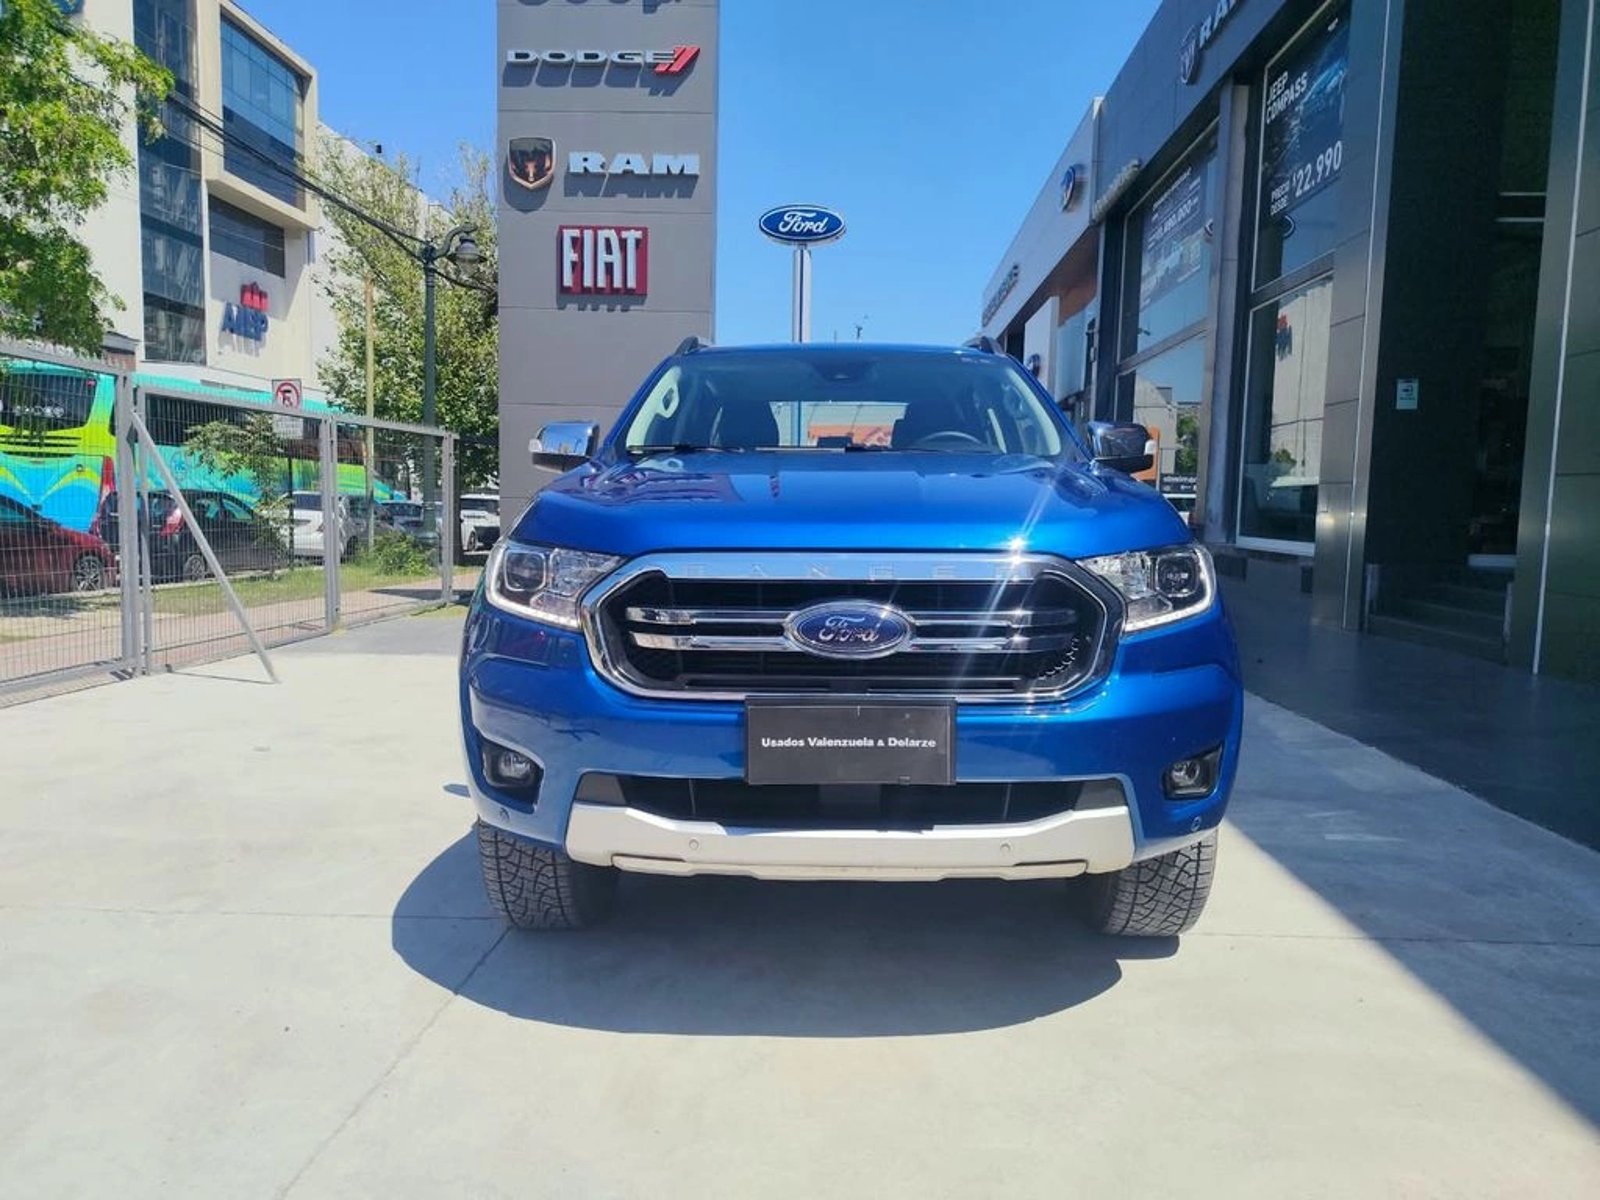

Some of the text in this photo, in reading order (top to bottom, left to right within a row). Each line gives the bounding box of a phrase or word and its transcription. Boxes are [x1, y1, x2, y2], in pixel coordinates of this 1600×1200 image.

[507, 49, 676, 64] DODGE
[1266, 72, 1307, 124] COMPASS
[1267, 71, 1288, 105] JEEP
[568, 151, 700, 175] RAM
[779, 211, 829, 232] Ford
[562, 228, 643, 289] FIAT
[819, 616, 879, 642] Ford
[762, 737, 805, 748] Usados
